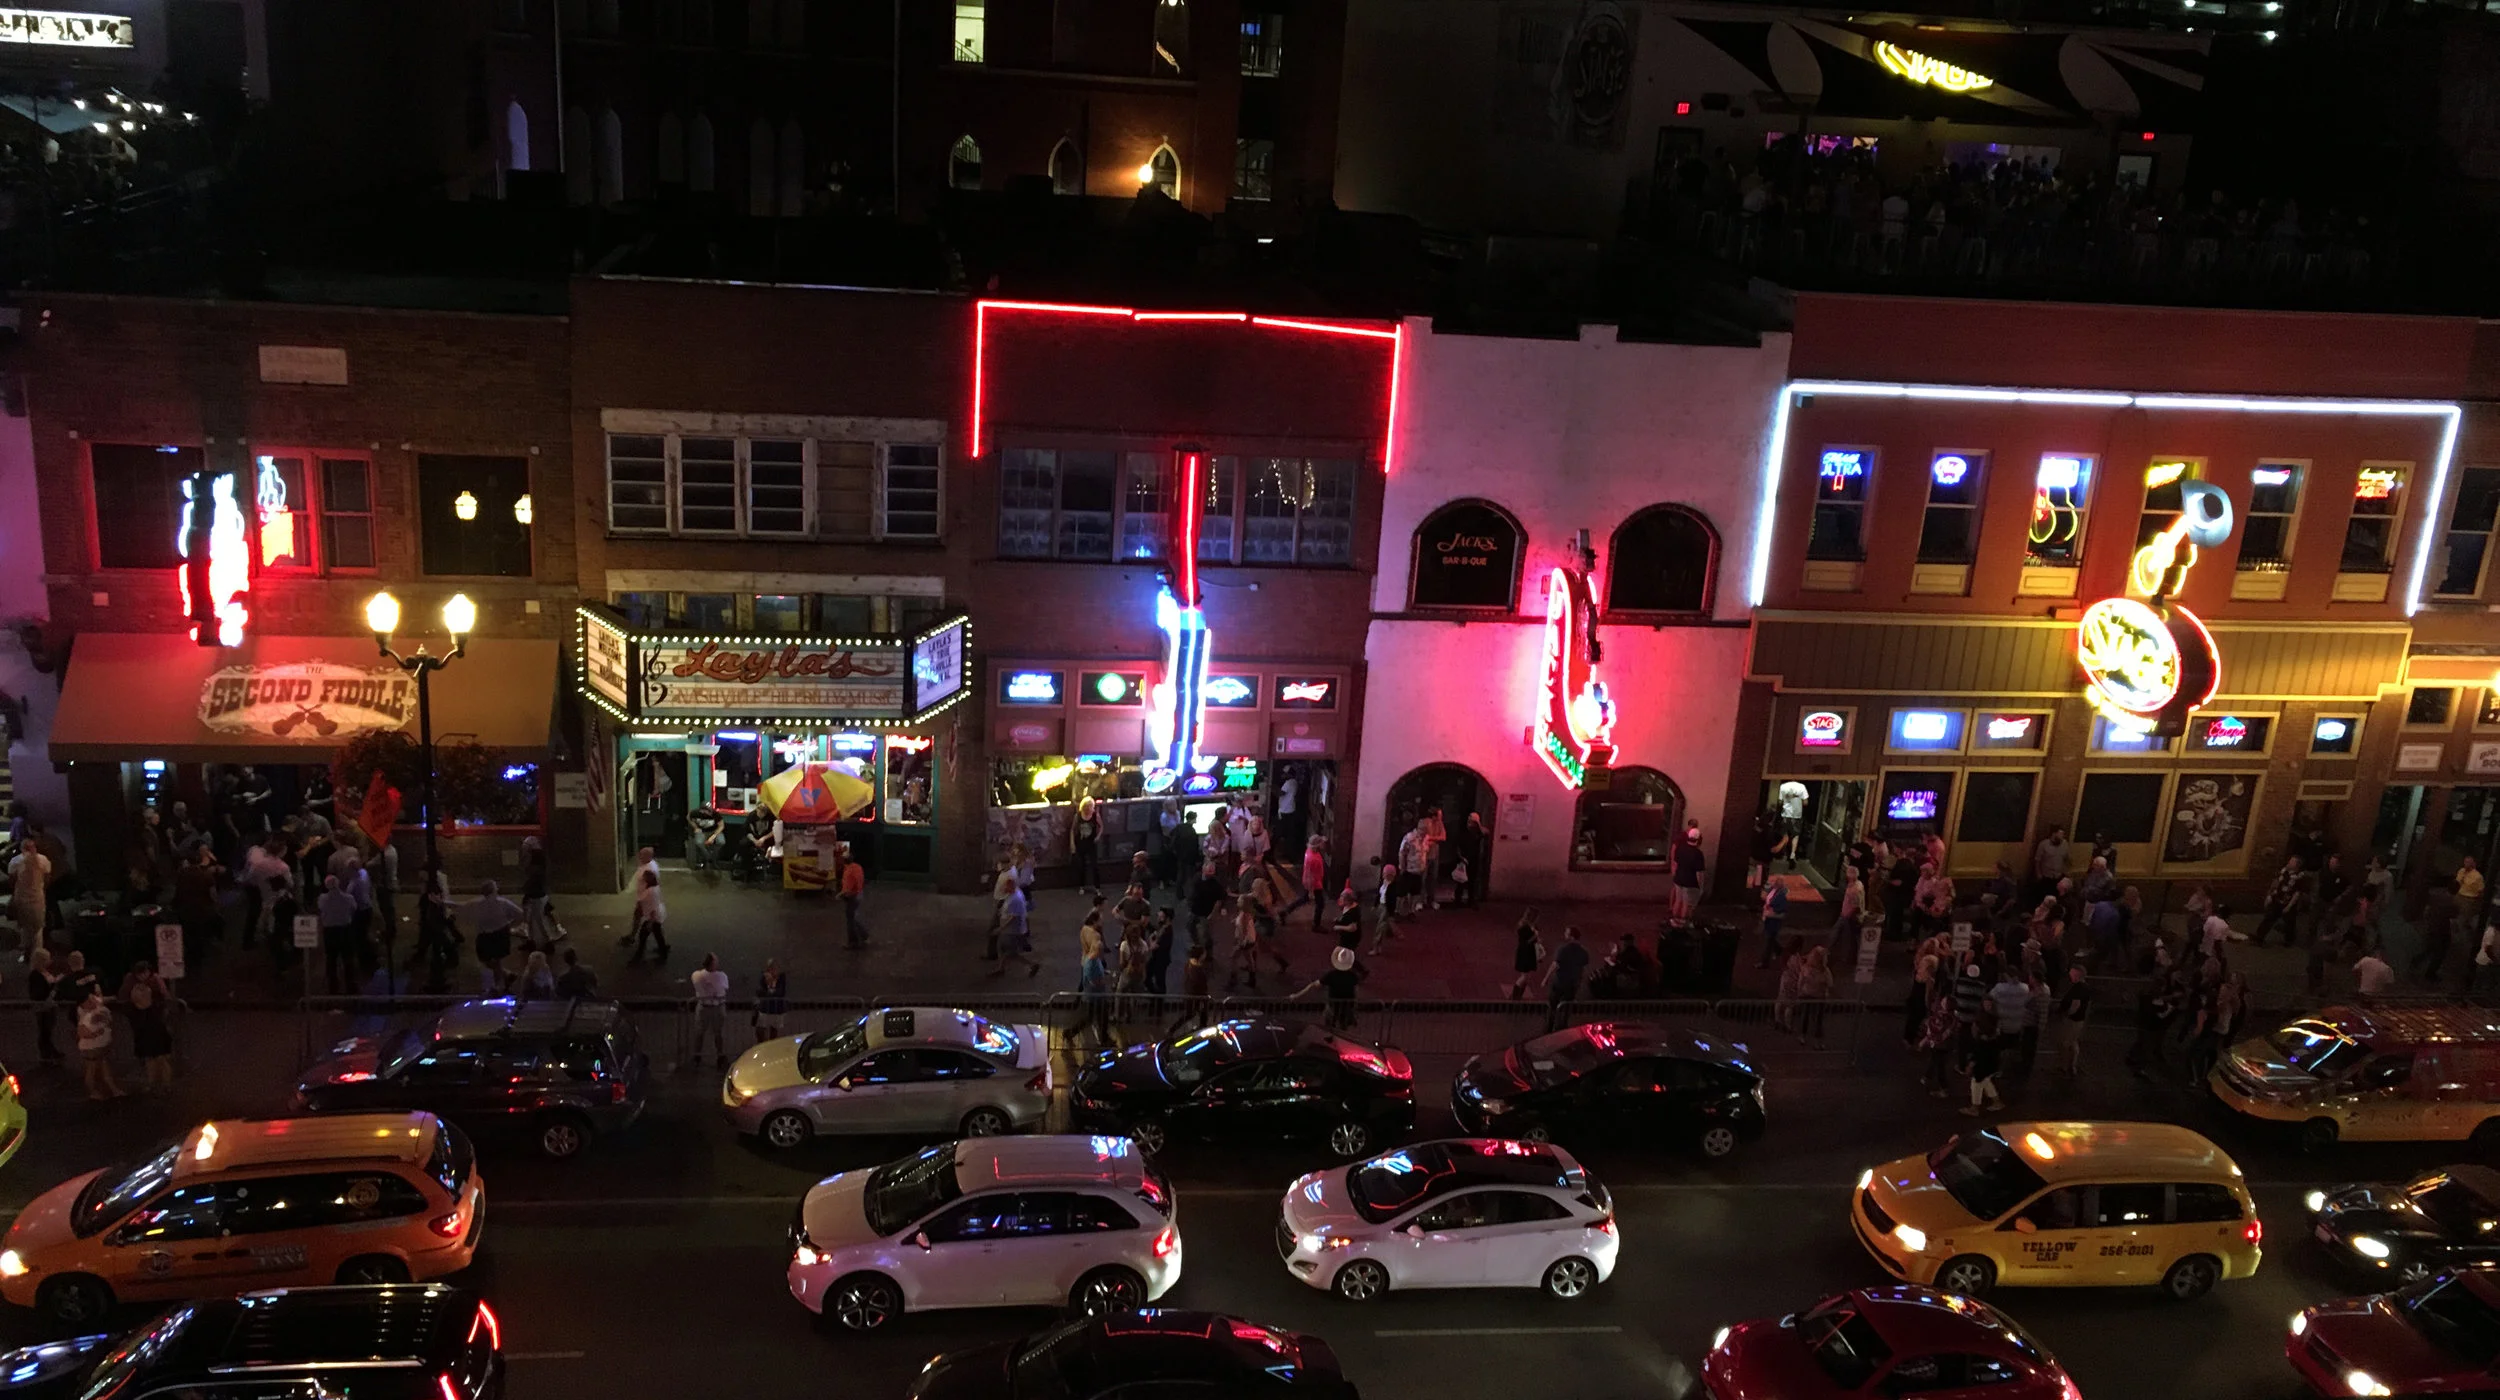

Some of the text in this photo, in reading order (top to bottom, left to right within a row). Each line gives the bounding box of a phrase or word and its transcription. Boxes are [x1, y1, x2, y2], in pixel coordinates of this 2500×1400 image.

[673, 641, 893, 684] Layla's
[207, 678, 409, 723] SECOND FIDDLE
[2207, 735, 2243, 746] LIGHT
[1224, 775, 1255, 788] ATM
[2022, 1241, 2078, 1252] YELLOW
[2035, 1252, 2060, 1262] CAB
